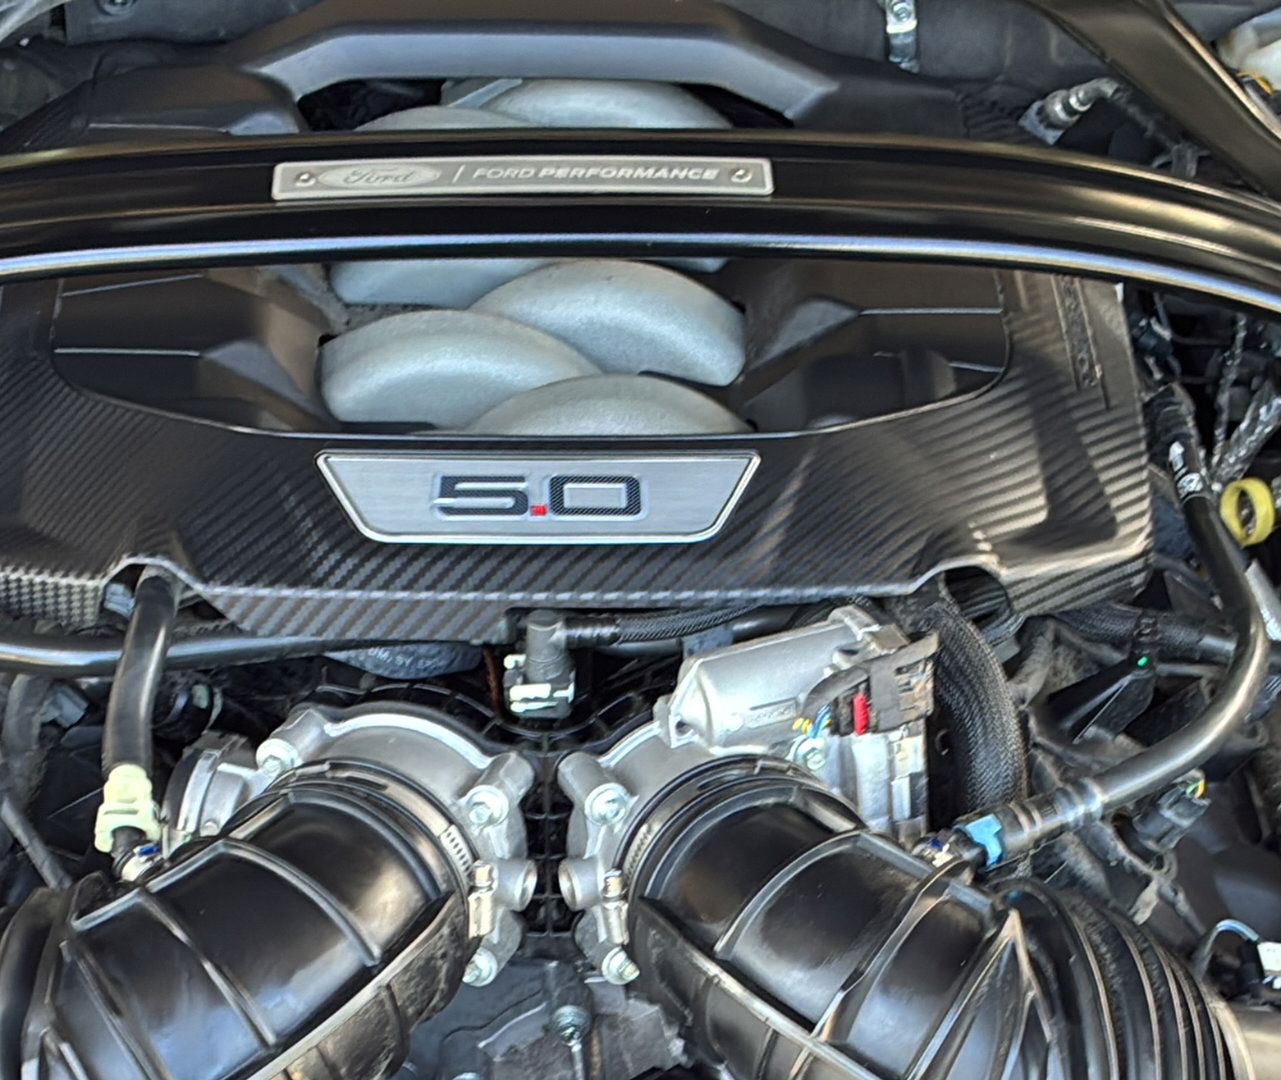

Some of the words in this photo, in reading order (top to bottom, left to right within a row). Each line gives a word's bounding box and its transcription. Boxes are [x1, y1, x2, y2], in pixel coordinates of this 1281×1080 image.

[343, 167, 415, 184] Ford
[472, 167, 536, 180] FORD
[537, 166, 720, 181] PERFORMANCE
[435, 475, 642, 517] 5.0
